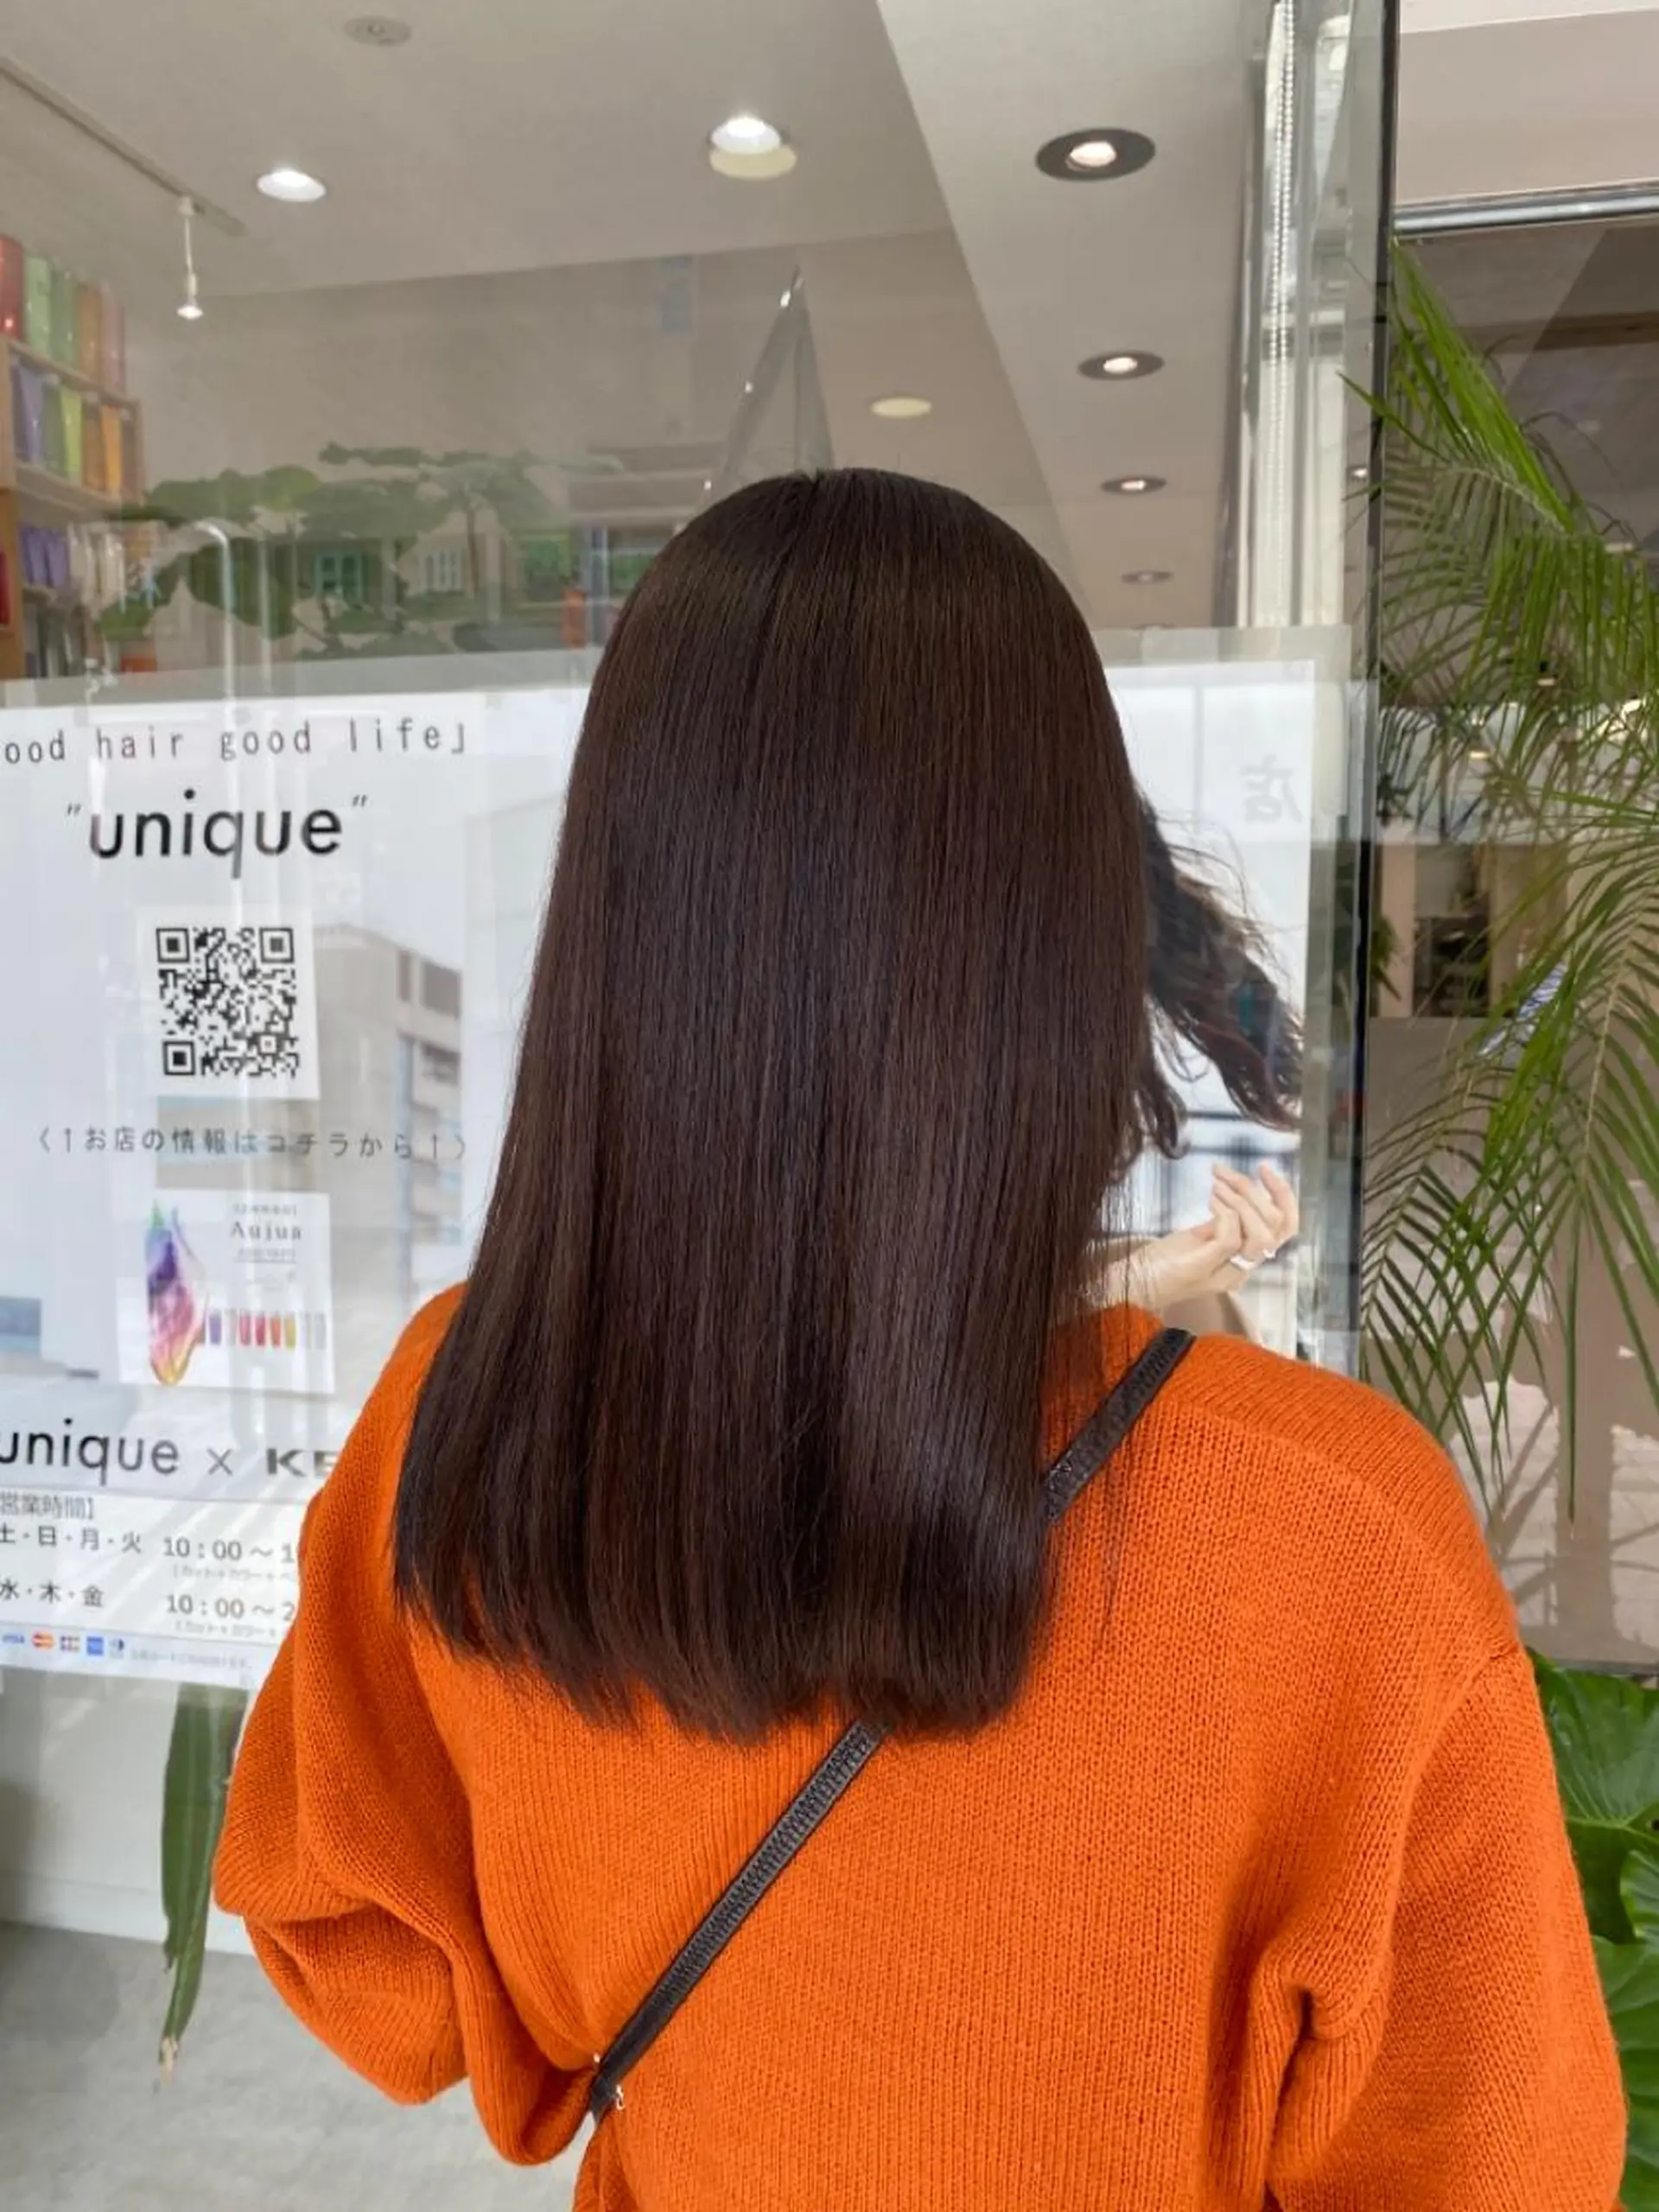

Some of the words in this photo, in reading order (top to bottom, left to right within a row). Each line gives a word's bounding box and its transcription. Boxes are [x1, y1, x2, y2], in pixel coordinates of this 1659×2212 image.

[95, 725, 184, 761] hair
[219, 721, 313, 761] good
[0, 1418, 180, 1486] unique
